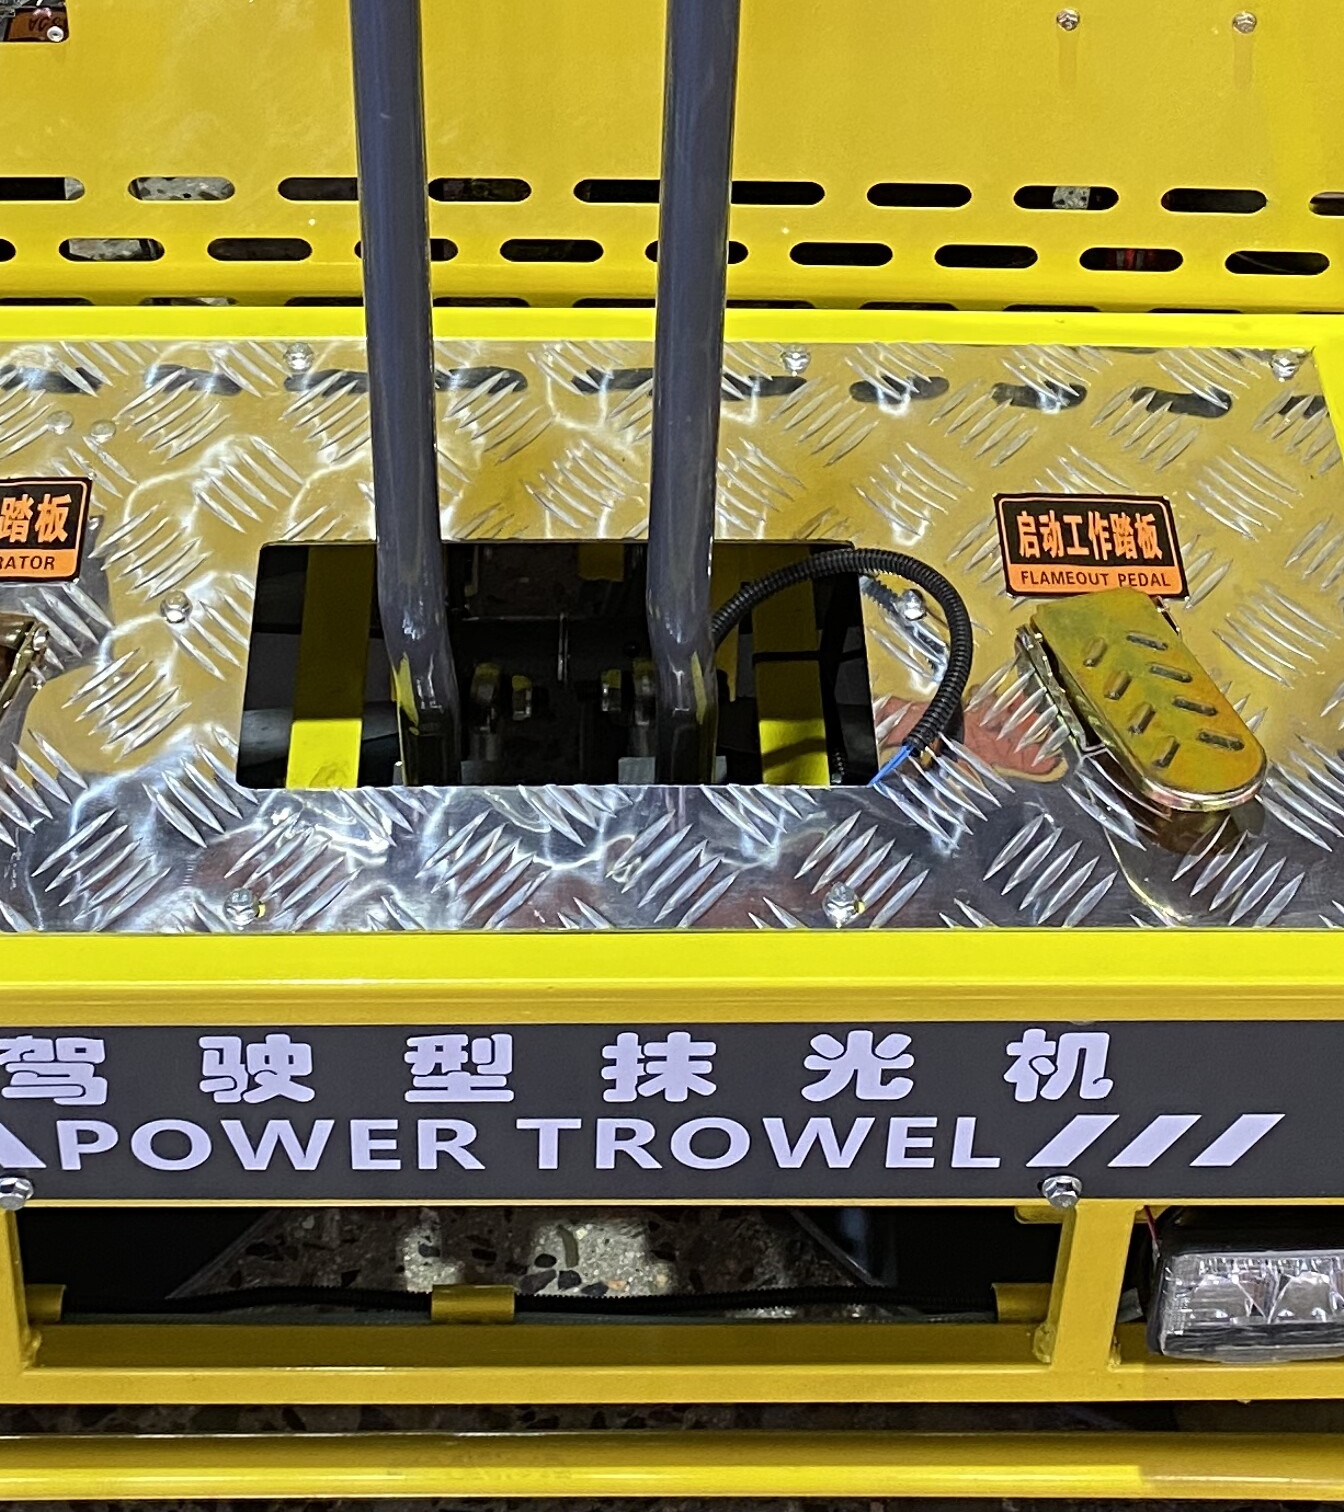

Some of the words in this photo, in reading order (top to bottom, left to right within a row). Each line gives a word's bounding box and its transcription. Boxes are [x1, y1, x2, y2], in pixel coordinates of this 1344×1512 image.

[1016, 509, 1163, 561] 启动工作踏板
[1021, 570, 1109, 586] FLAMEOUT
[1117, 573, 1172, 587] PEDAL
[58, 1119, 485, 1171] POWER
[517, 1116, 1001, 1170] TROWEL
